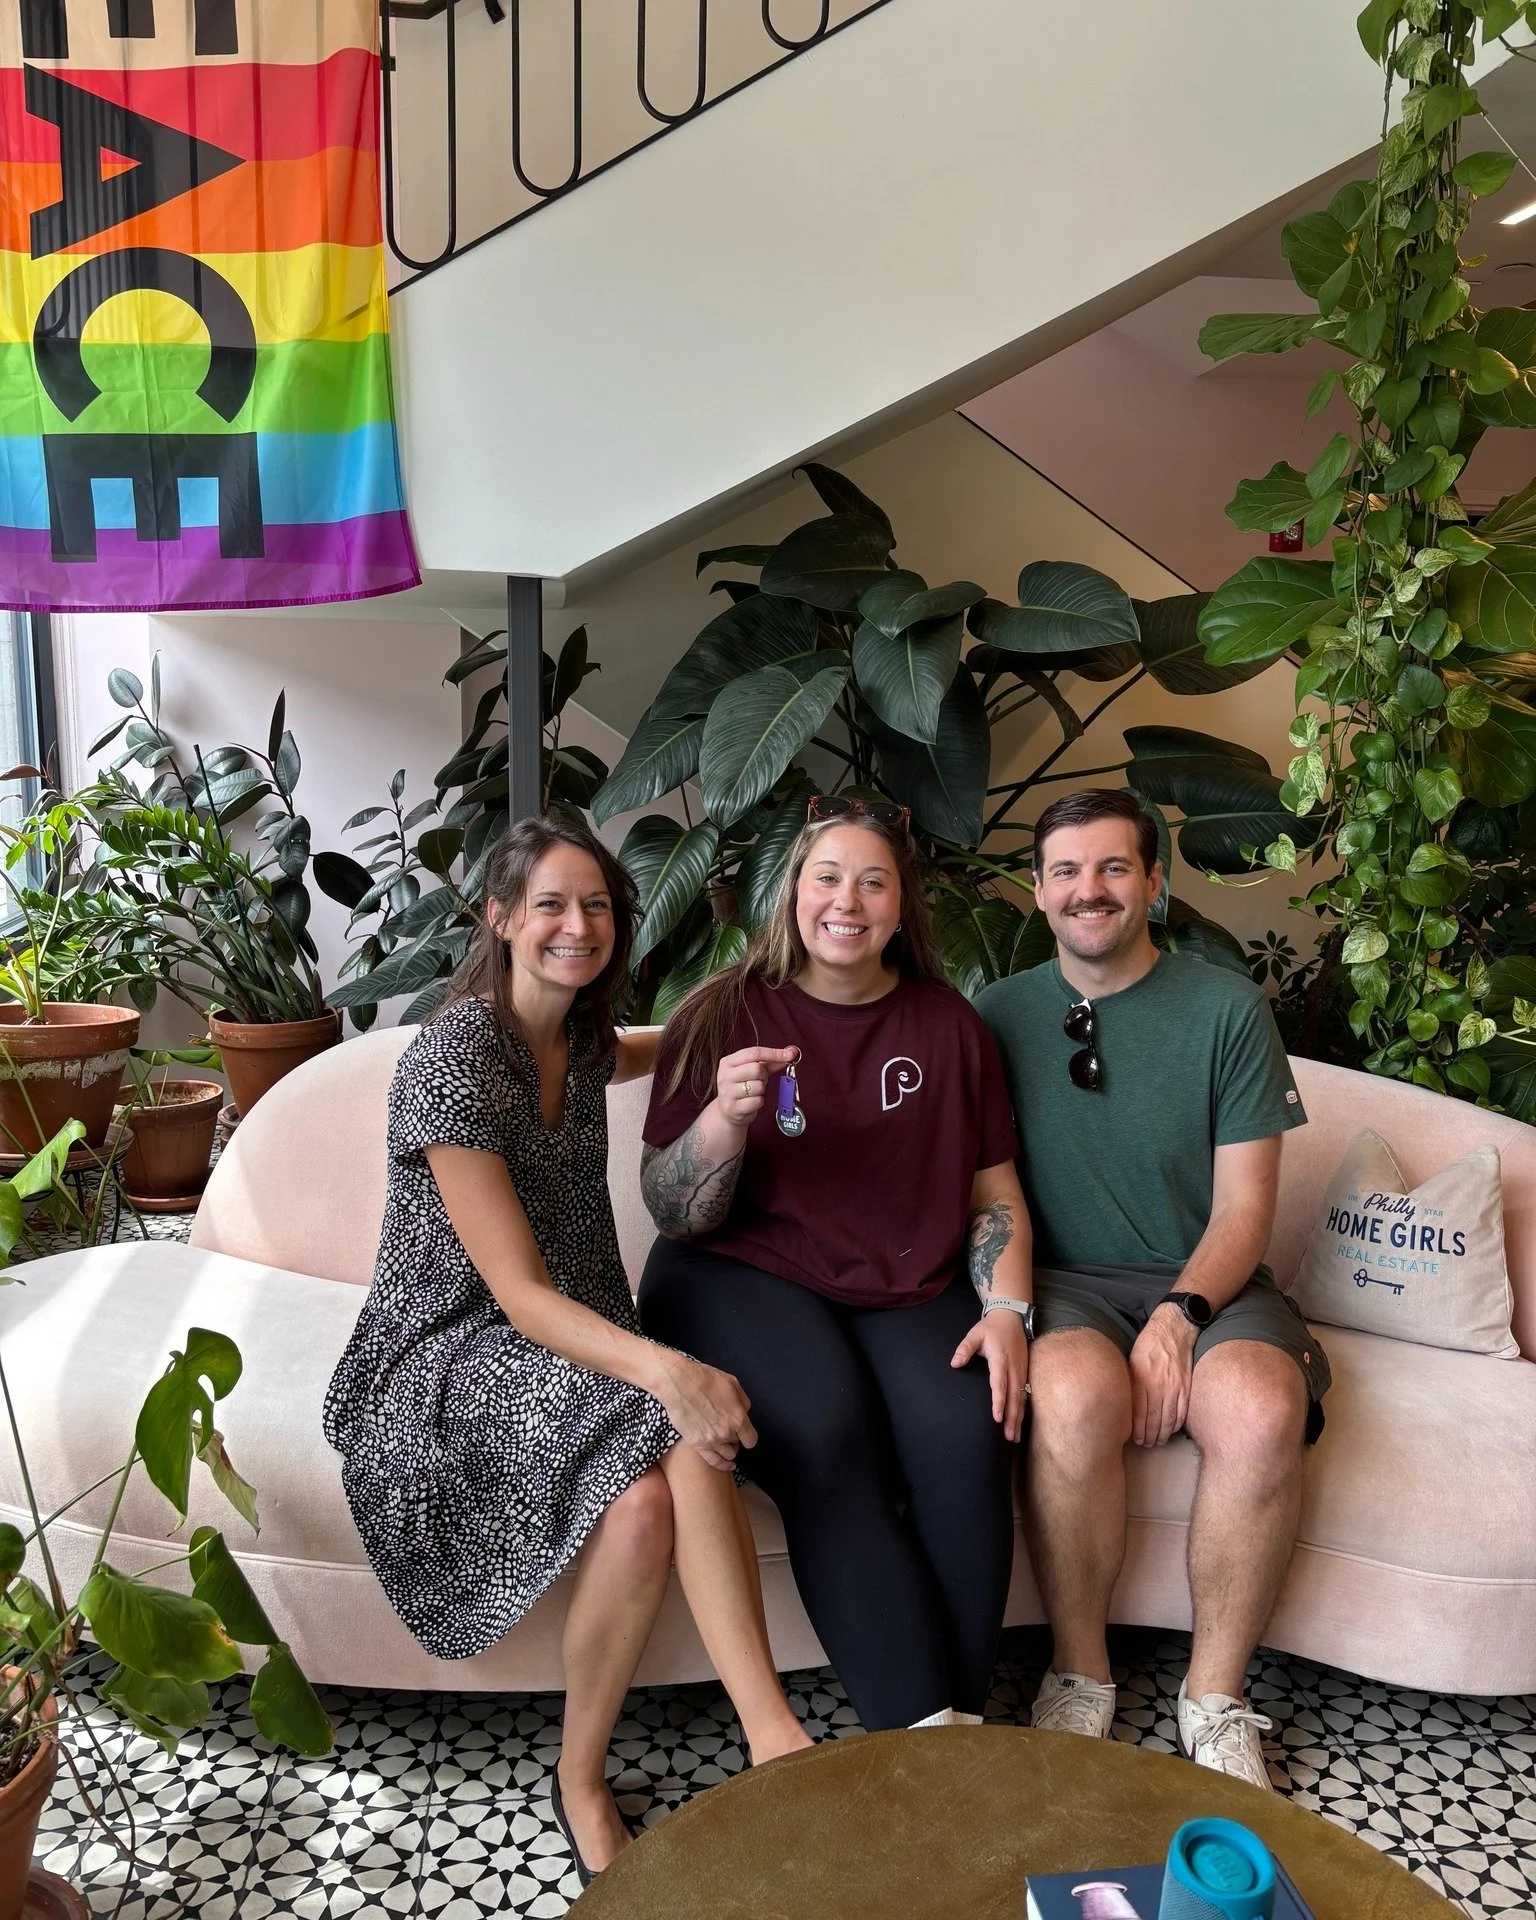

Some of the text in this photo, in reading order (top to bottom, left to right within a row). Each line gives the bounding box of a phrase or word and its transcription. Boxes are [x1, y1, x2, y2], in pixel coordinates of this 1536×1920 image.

[1363, 1192, 1416, 1222] Philly
[1326, 1206, 1466, 1257] HOME GIRLS
[1337, 1243, 1440, 1275] REAL ESTATE
